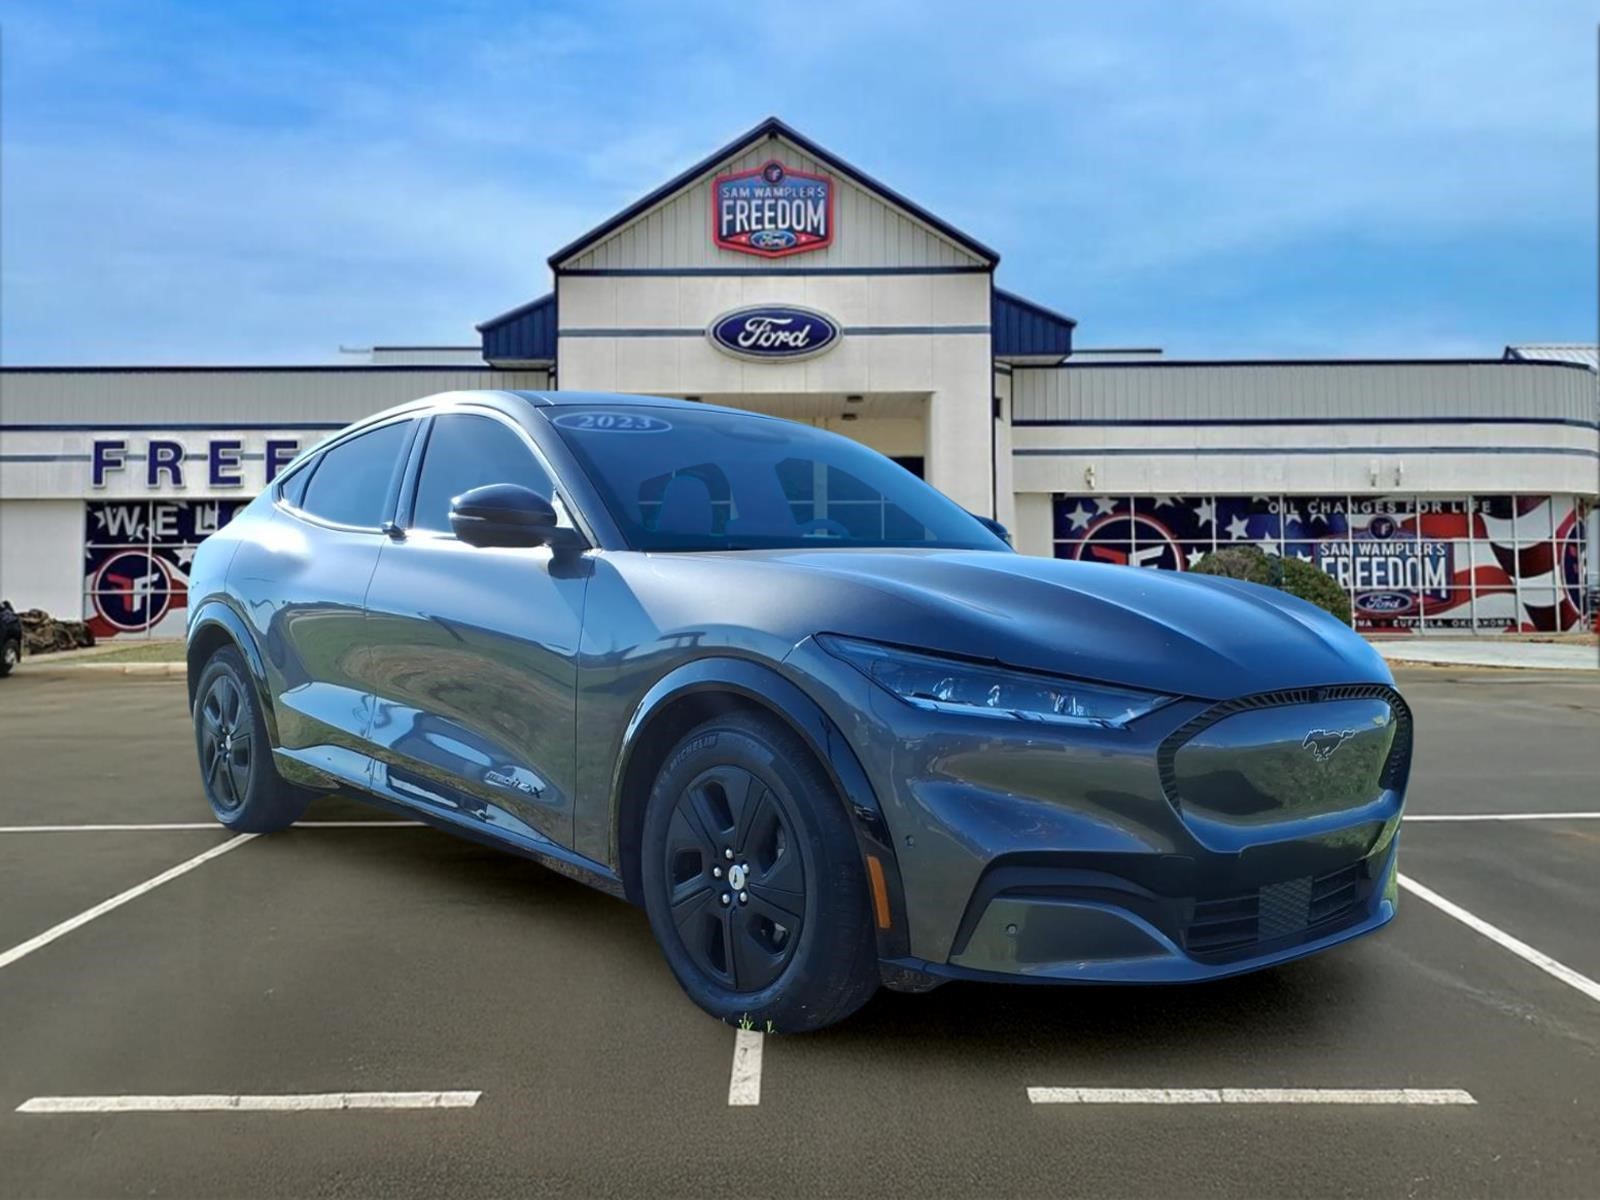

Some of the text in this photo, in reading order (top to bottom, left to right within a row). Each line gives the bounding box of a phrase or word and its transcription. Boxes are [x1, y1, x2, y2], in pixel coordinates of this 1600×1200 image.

[722, 187, 825, 199] SAM WAMPLER'S
[721, 199, 825, 236] FREEDOM
[737, 316, 811, 348] Ford
[578, 415, 652, 429] 2023
[1267, 501, 1492, 514] OIL CHANGES FOR LIFE
[1366, 595, 1400, 609] Ford
